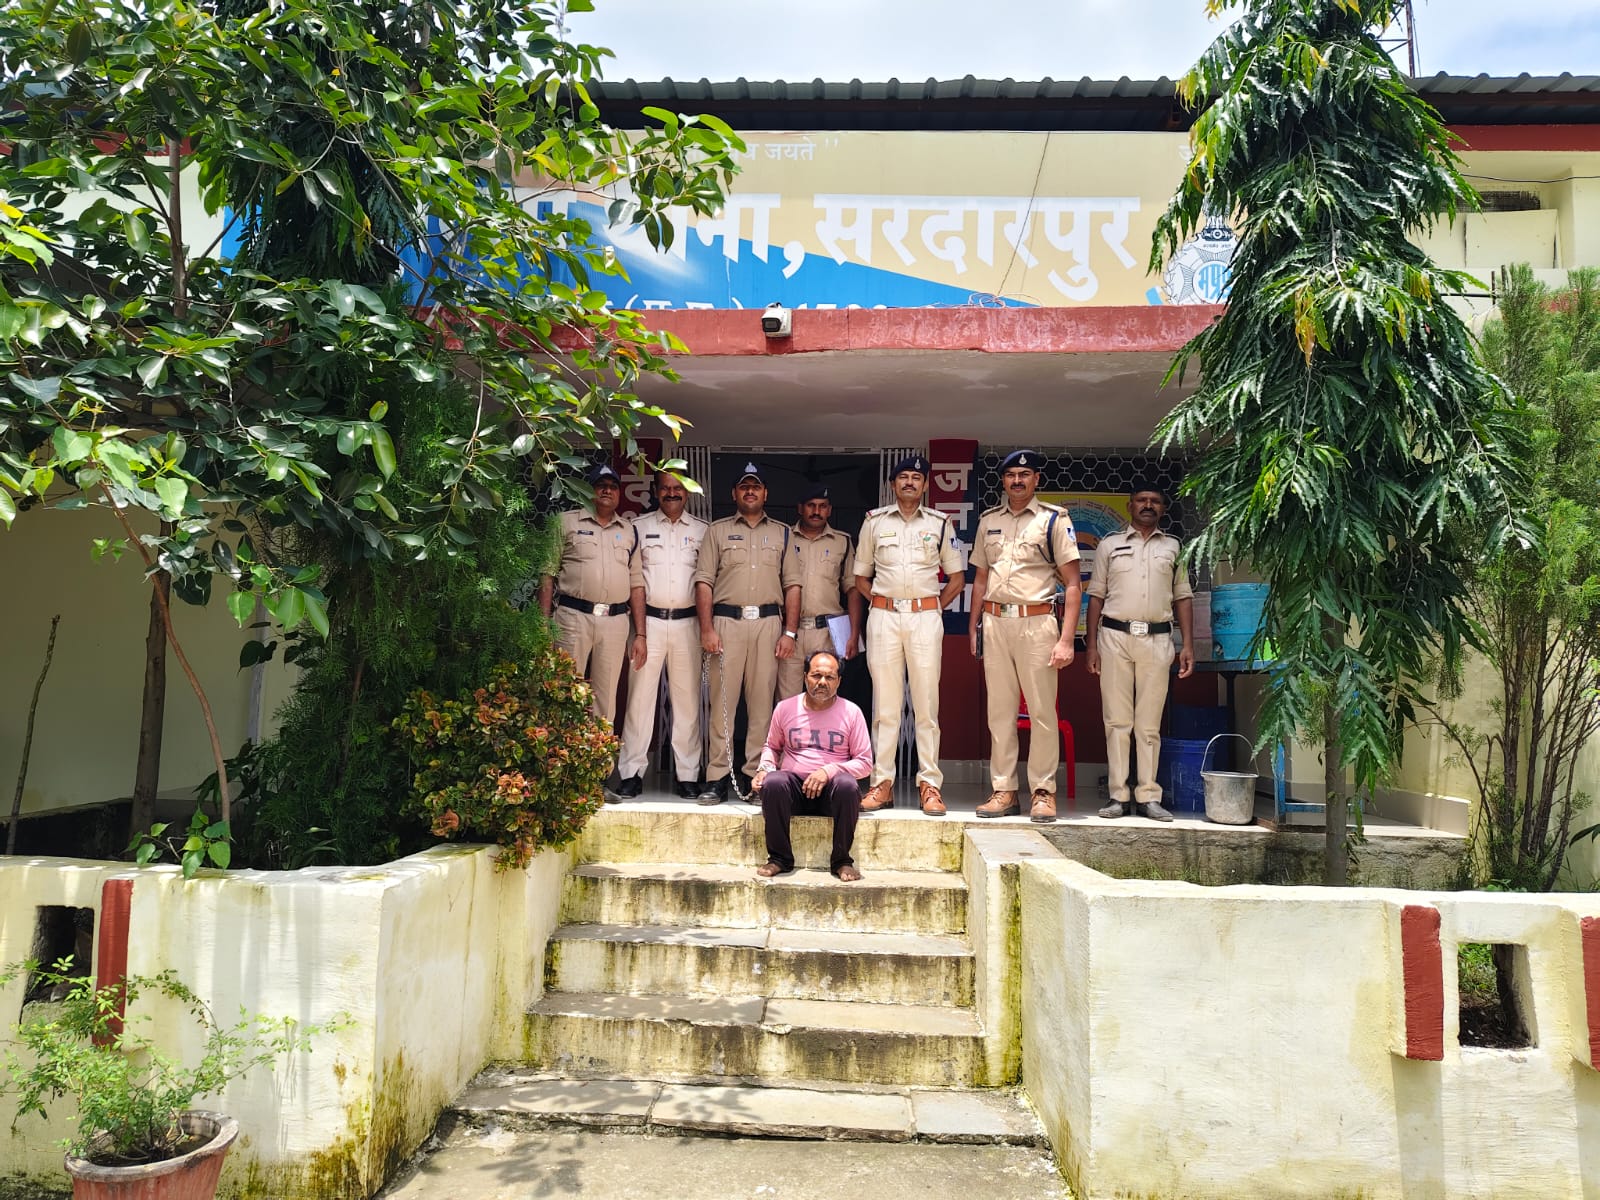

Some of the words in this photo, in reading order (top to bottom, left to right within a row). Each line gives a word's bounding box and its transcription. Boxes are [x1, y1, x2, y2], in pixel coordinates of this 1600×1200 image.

[764, 136, 816, 161] जयते
[813, 193, 1141, 302] सरदारपुर
[788, 727, 845, 752] GAP
